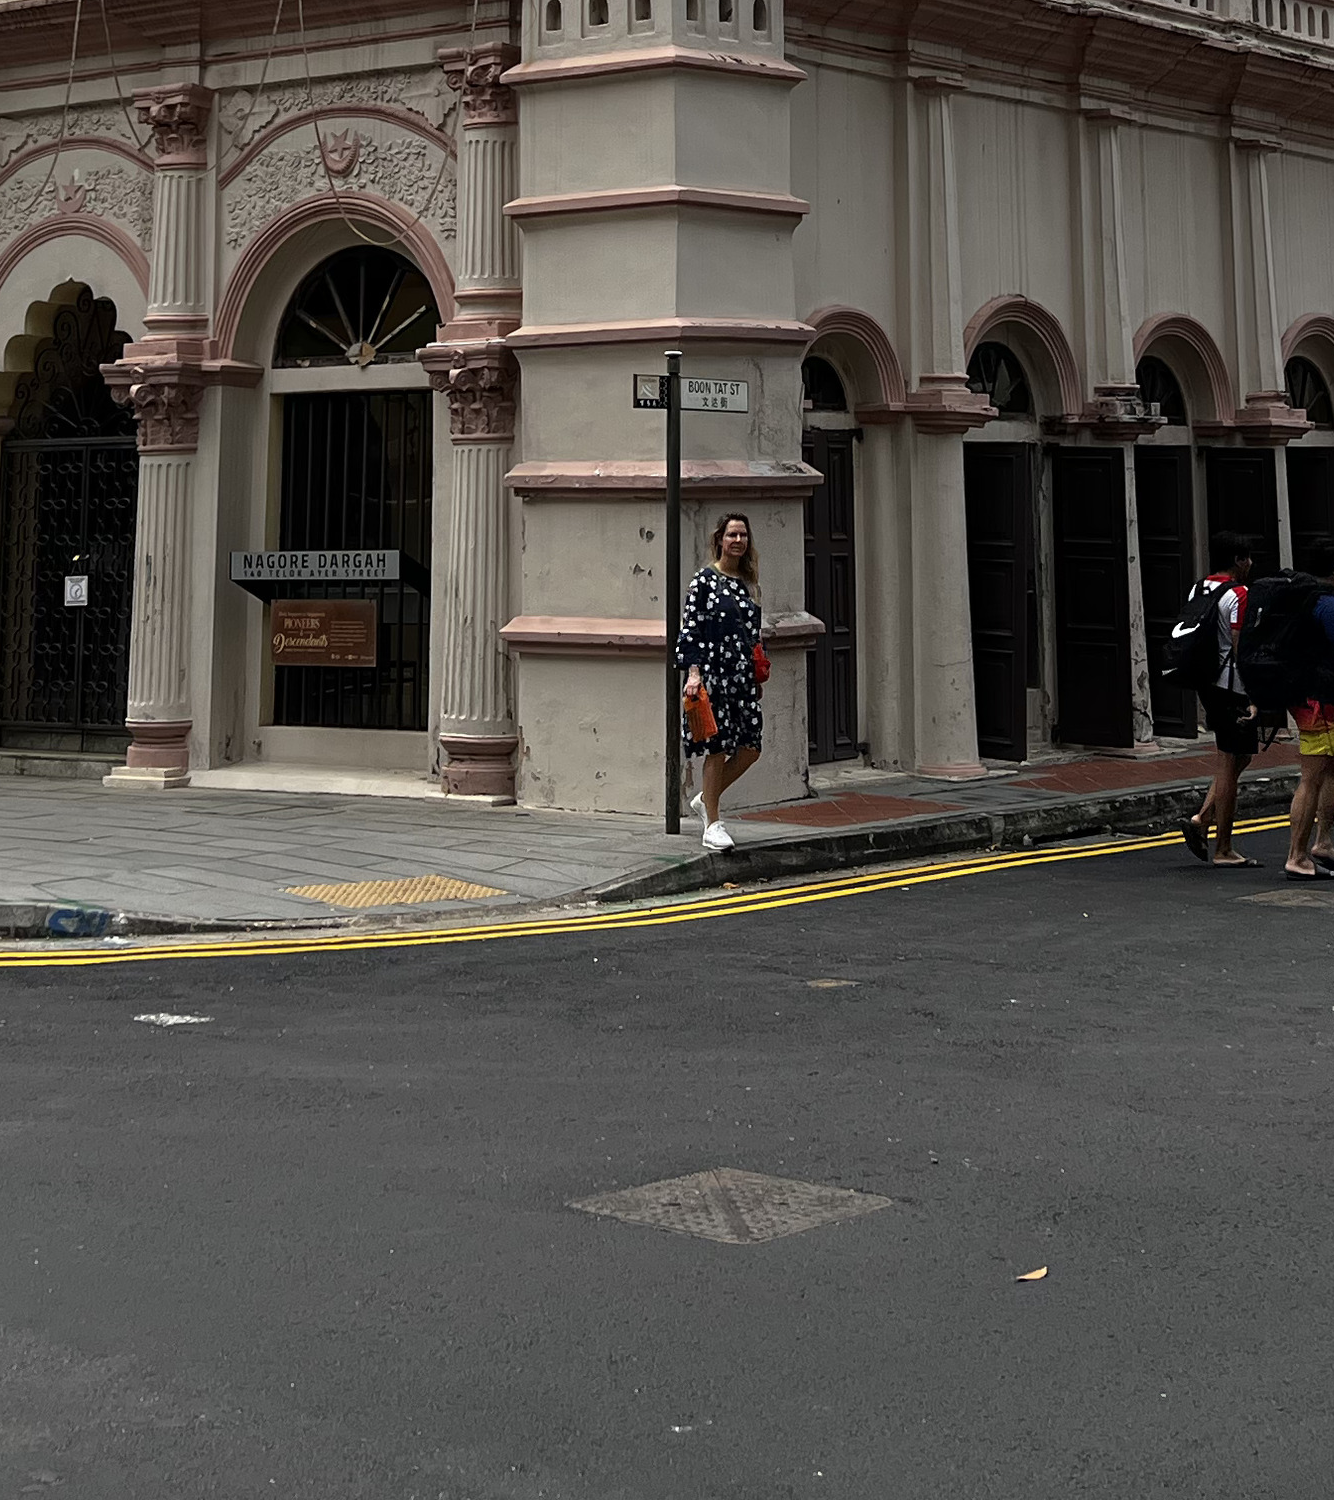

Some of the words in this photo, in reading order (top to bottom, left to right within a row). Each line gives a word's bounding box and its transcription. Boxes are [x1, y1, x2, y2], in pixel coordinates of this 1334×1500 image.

[688, 381, 712, 394] BOON
[713, 382, 728, 395] TAT
[730, 383, 741, 396] ST
[243, 553, 310, 569] NAGORE
[318, 553, 387, 569] DARGAH
[269, 569, 303, 578] TELOK
[310, 569, 338, 578] AYER
[345, 568, 387, 578] STREET
